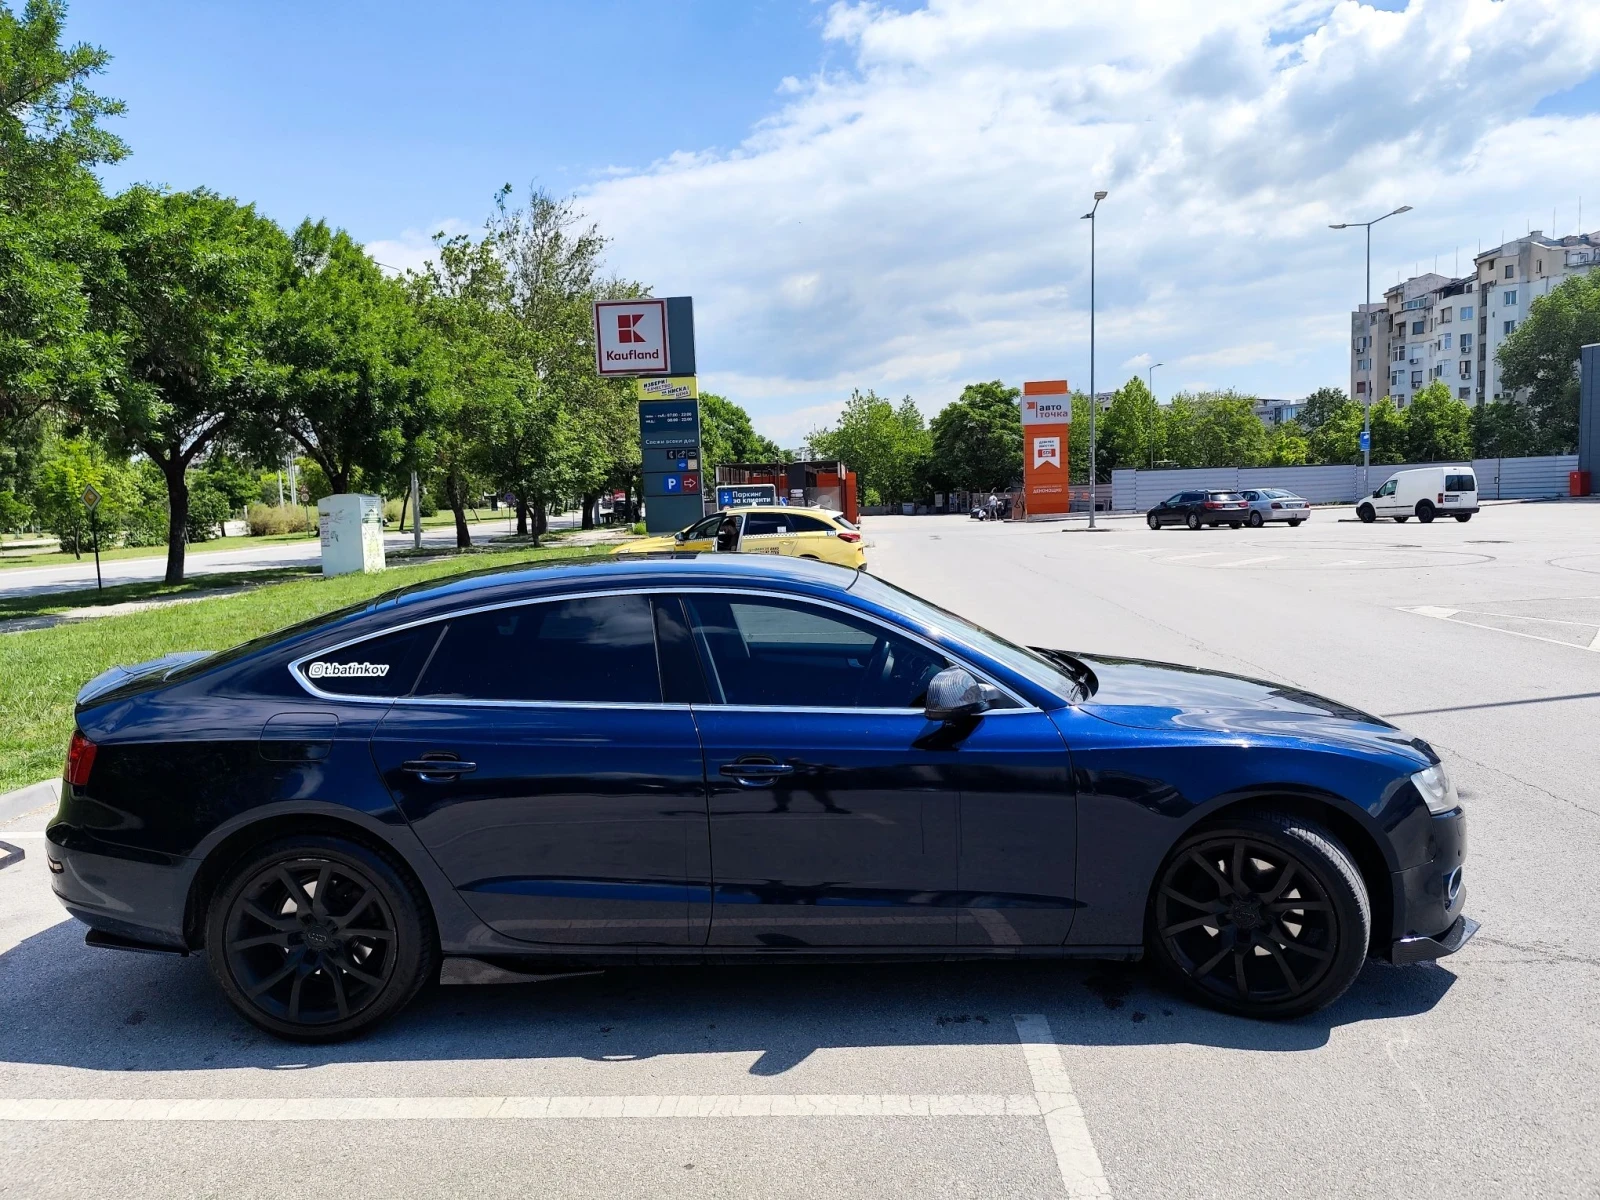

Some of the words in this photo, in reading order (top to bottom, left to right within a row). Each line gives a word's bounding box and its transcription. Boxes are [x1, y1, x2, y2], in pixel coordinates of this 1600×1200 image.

[606, 348, 659, 361] Kaufland
[1040, 411, 1068, 419] точка
[668, 478, 676, 490] P
[732, 490, 762, 499] Паркинг
[324, 663, 388, 676] t.batinkov
